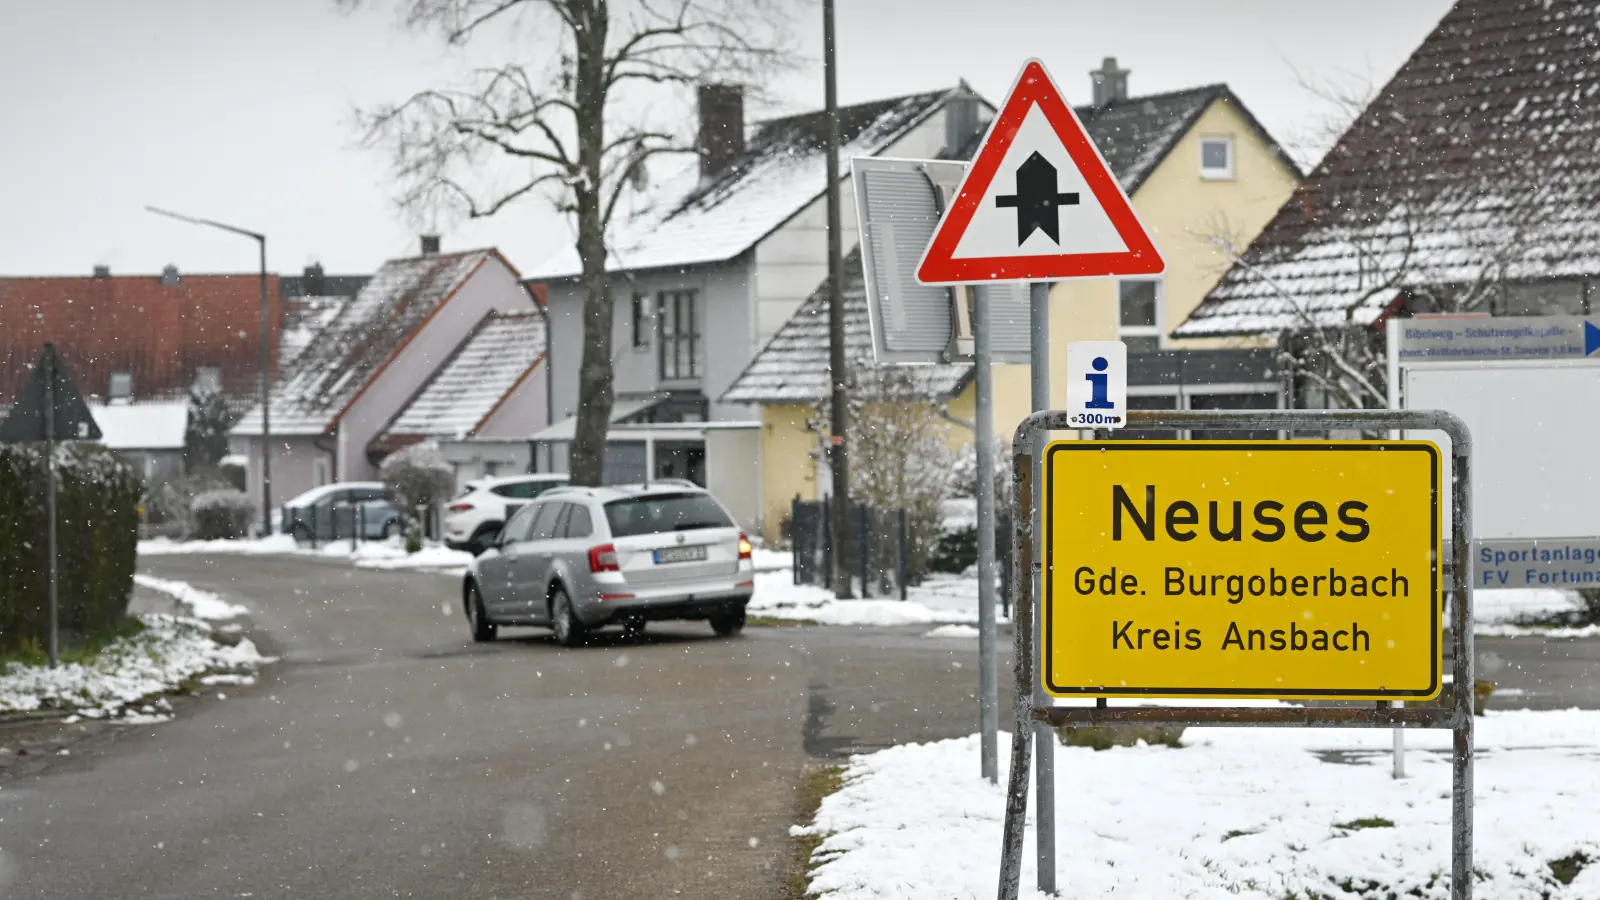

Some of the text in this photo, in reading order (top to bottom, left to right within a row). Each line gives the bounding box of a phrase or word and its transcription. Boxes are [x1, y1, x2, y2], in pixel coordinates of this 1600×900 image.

[1405, 328, 1453, 341] Bibelweg
[1112, 484, 1371, 542] Neuses
[1074, 566, 1410, 604] Gde. Burgoberbach
[1482, 570, 1510, 585] FV
[1112, 620, 1371, 652] Kreis Ansbach
